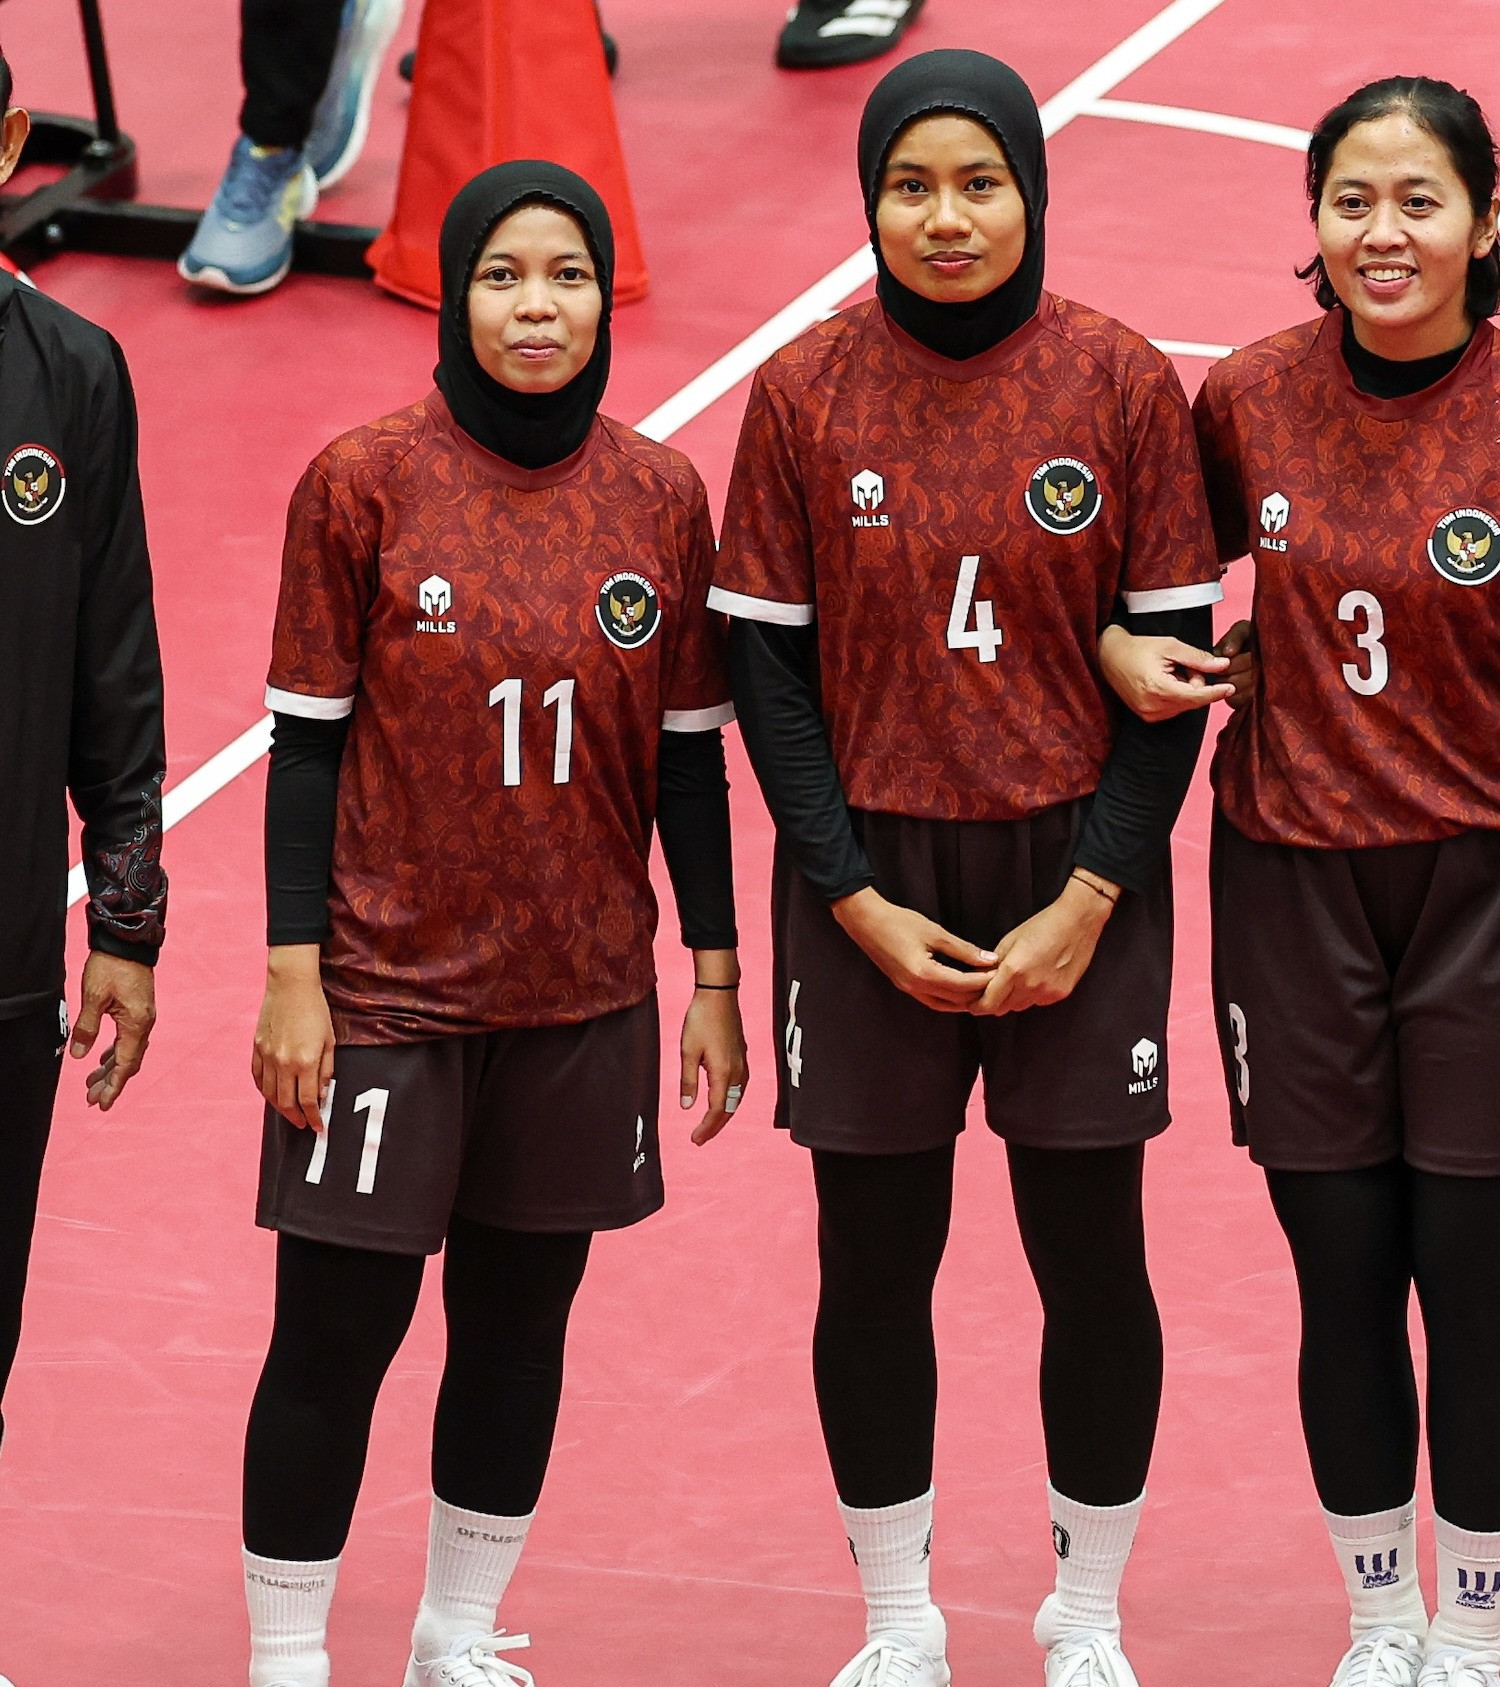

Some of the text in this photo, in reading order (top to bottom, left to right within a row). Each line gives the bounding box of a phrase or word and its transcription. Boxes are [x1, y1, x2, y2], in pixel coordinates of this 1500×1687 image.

[4, 448, 56, 476] TIM INDONESIA
[1032, 457, 1094, 482] TIM INDONESIA
[851, 514, 889, 527] MILLS
[1436, 508, 1500, 536] TIM INDONESIA
[1259, 536, 1288, 552] MILLS
[600, 572, 655, 598] TIM INDONESIA
[947, 555, 1003, 663] 4
[416, 620, 457, 634] MILLS
[1337, 590, 1389, 695] 3
[488, 678, 575, 786] 11
[1229, 1003, 1250, 1106] 3
[1128, 1076, 1158, 1096] MILLS
[305, 1079, 390, 1195] 11
